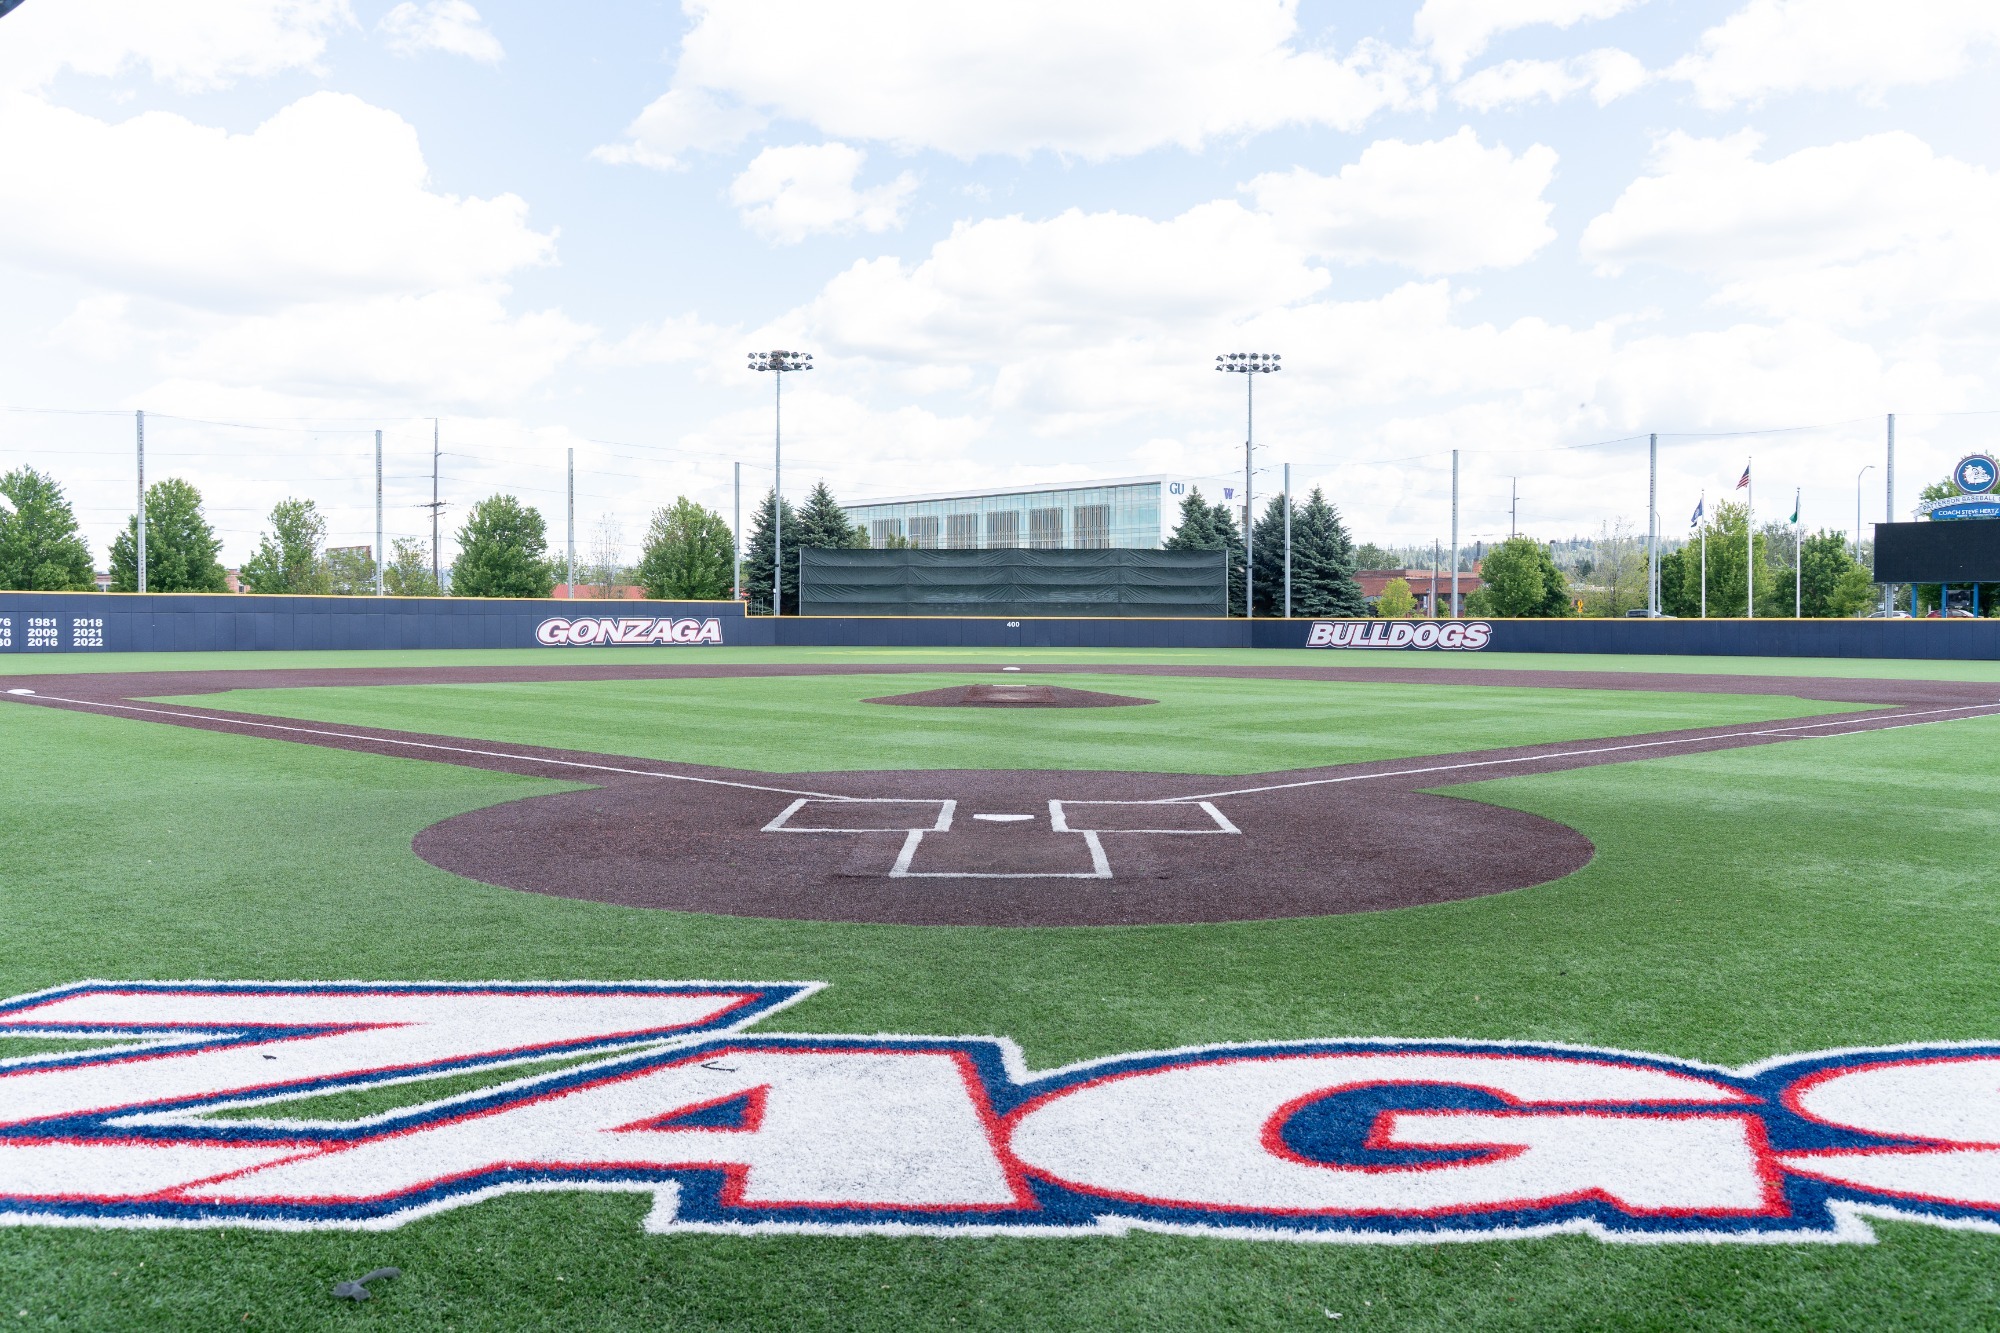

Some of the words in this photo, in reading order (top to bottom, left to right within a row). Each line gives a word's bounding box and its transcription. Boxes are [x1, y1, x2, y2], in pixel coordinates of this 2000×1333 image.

[1169, 482, 1185, 495] GU
[1223, 487, 1235, 500] W
[27, 618, 57, 627] 1981
[73, 618, 103, 627] 2018
[27, 628, 58, 637] 2009
[73, 628, 102, 637] 2021
[535, 618, 724, 646] GONZAGA
[1306, 621, 1492, 650] BULLDOGS
[27, 638, 58, 647] 2016
[73, 638, 103, 647] 2022
